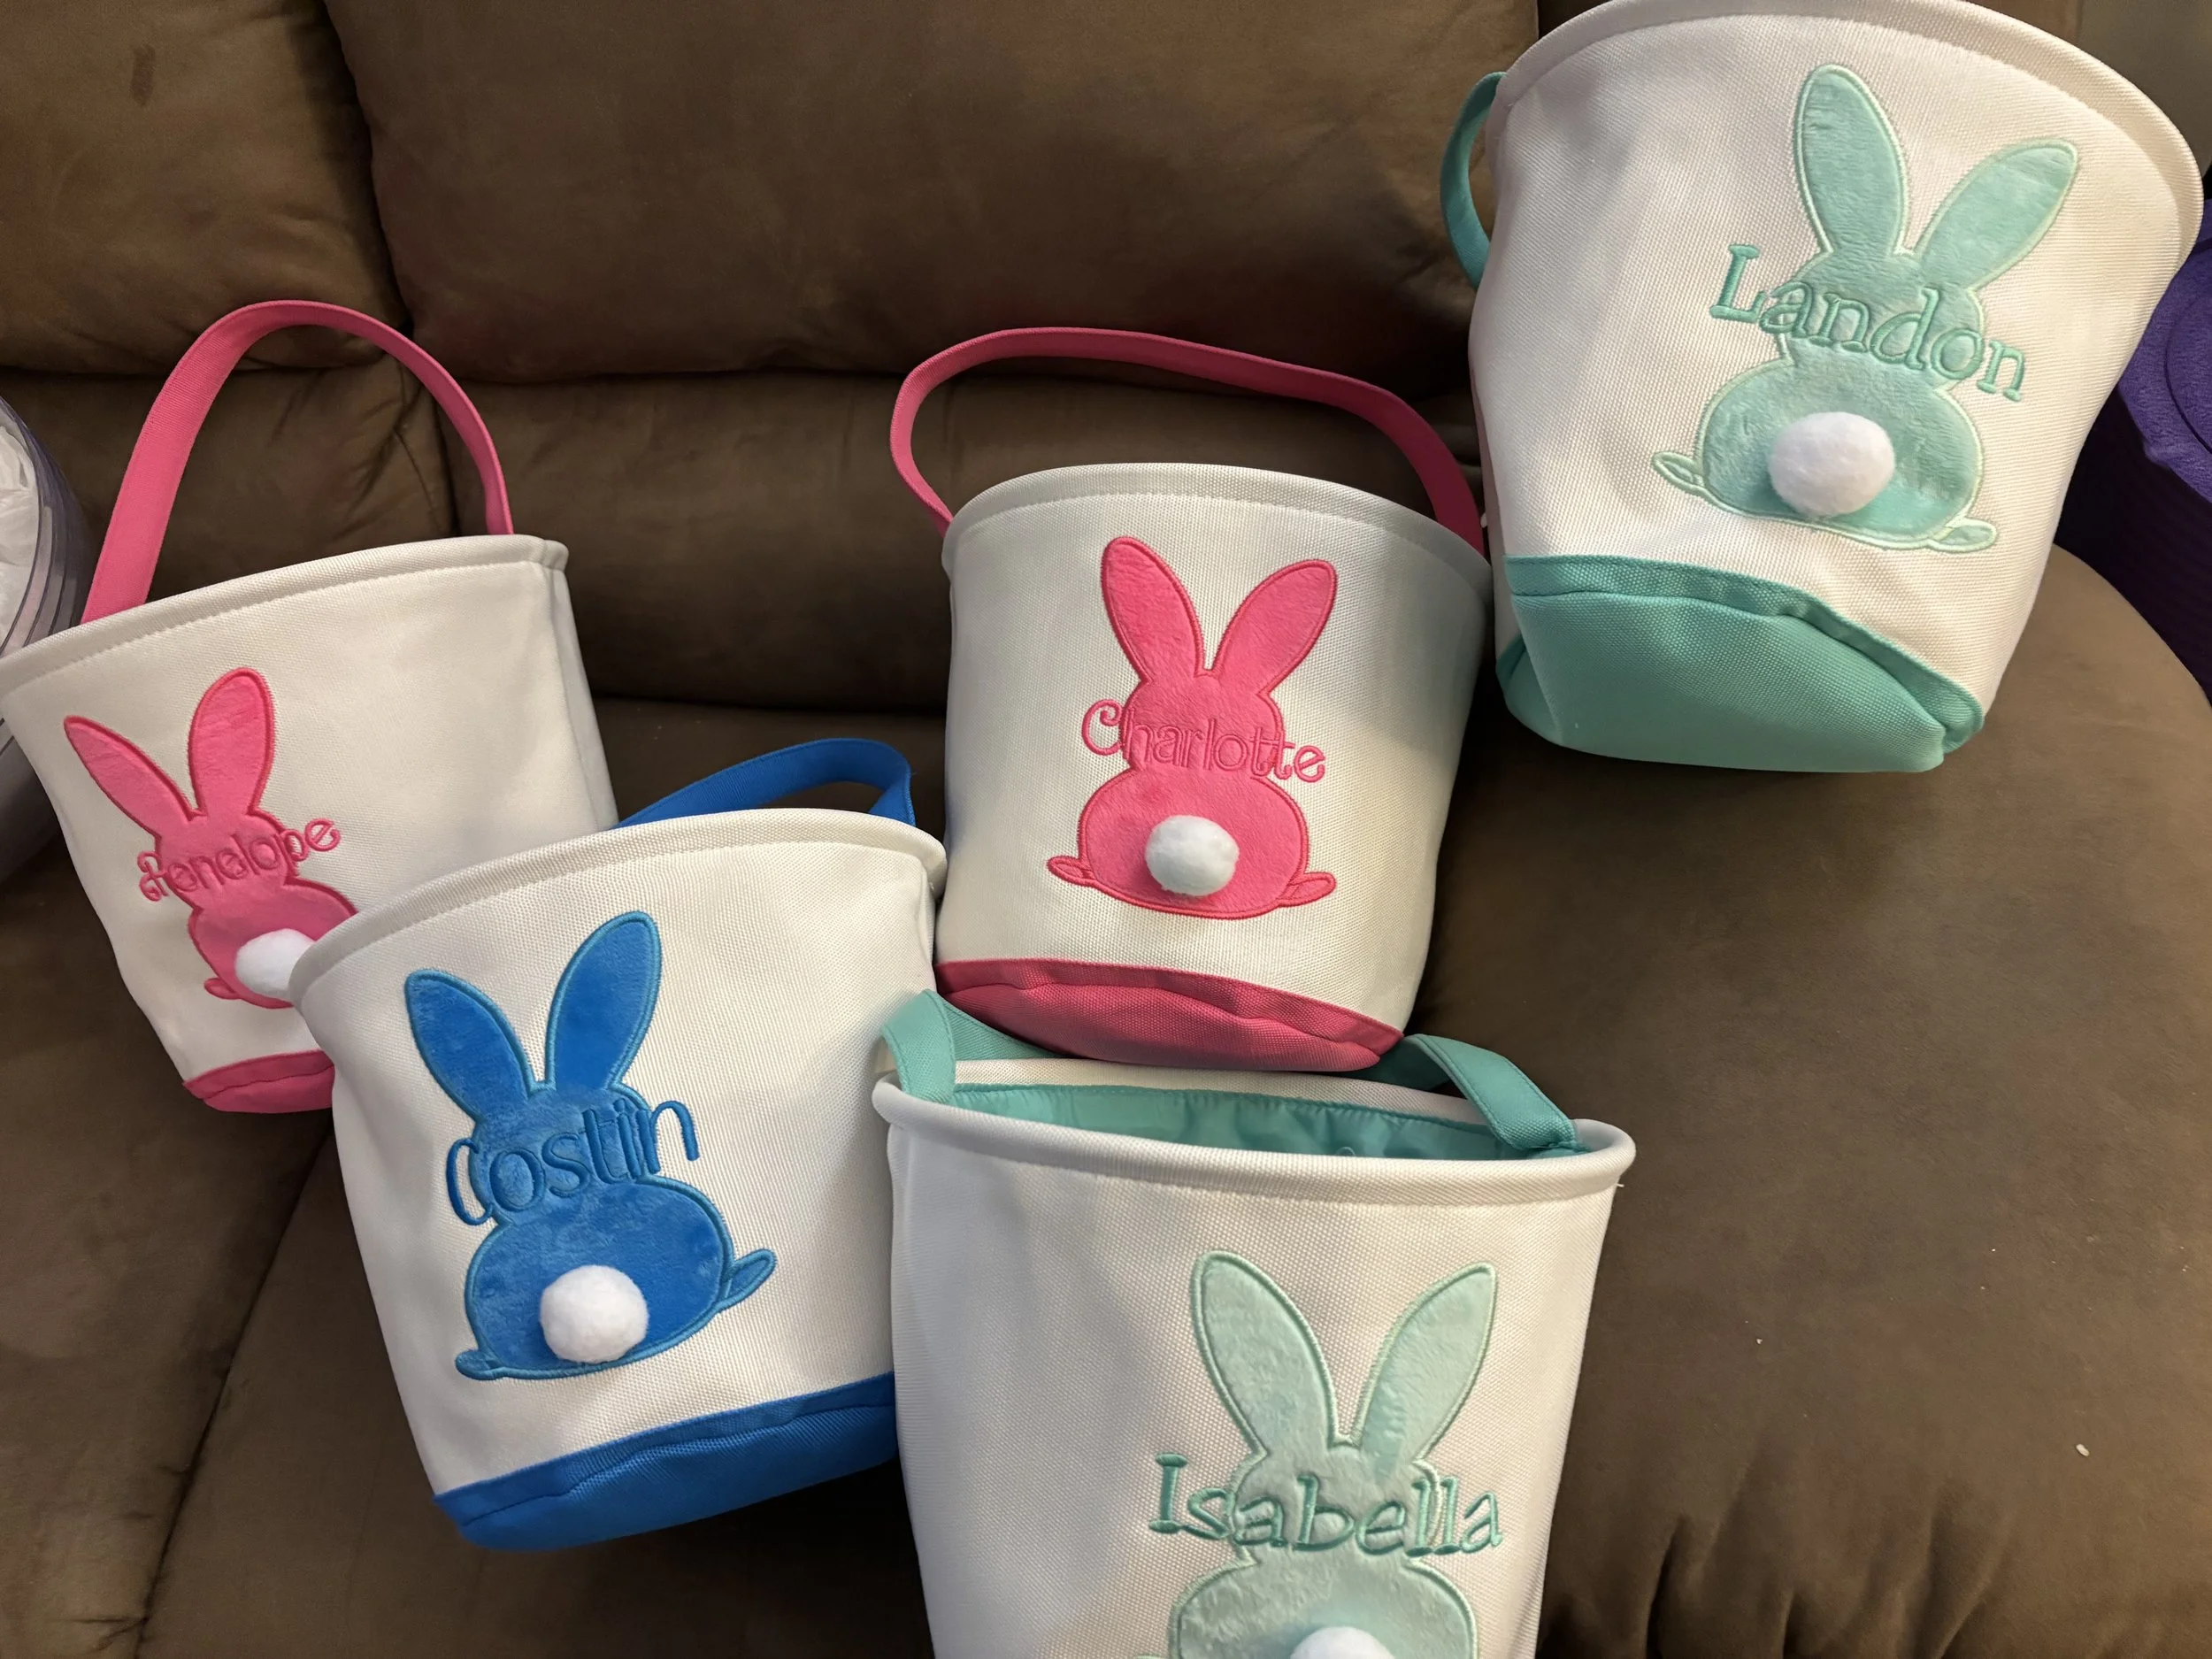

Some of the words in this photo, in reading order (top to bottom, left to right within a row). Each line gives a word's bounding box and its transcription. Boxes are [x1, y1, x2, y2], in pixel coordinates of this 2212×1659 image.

[1709, 244, 2025, 402] Landon
[1081, 699, 1325, 782] Charlotte
[137, 818, 341, 901] Penelope
[1148, 1452, 1503, 1556] Isabella
